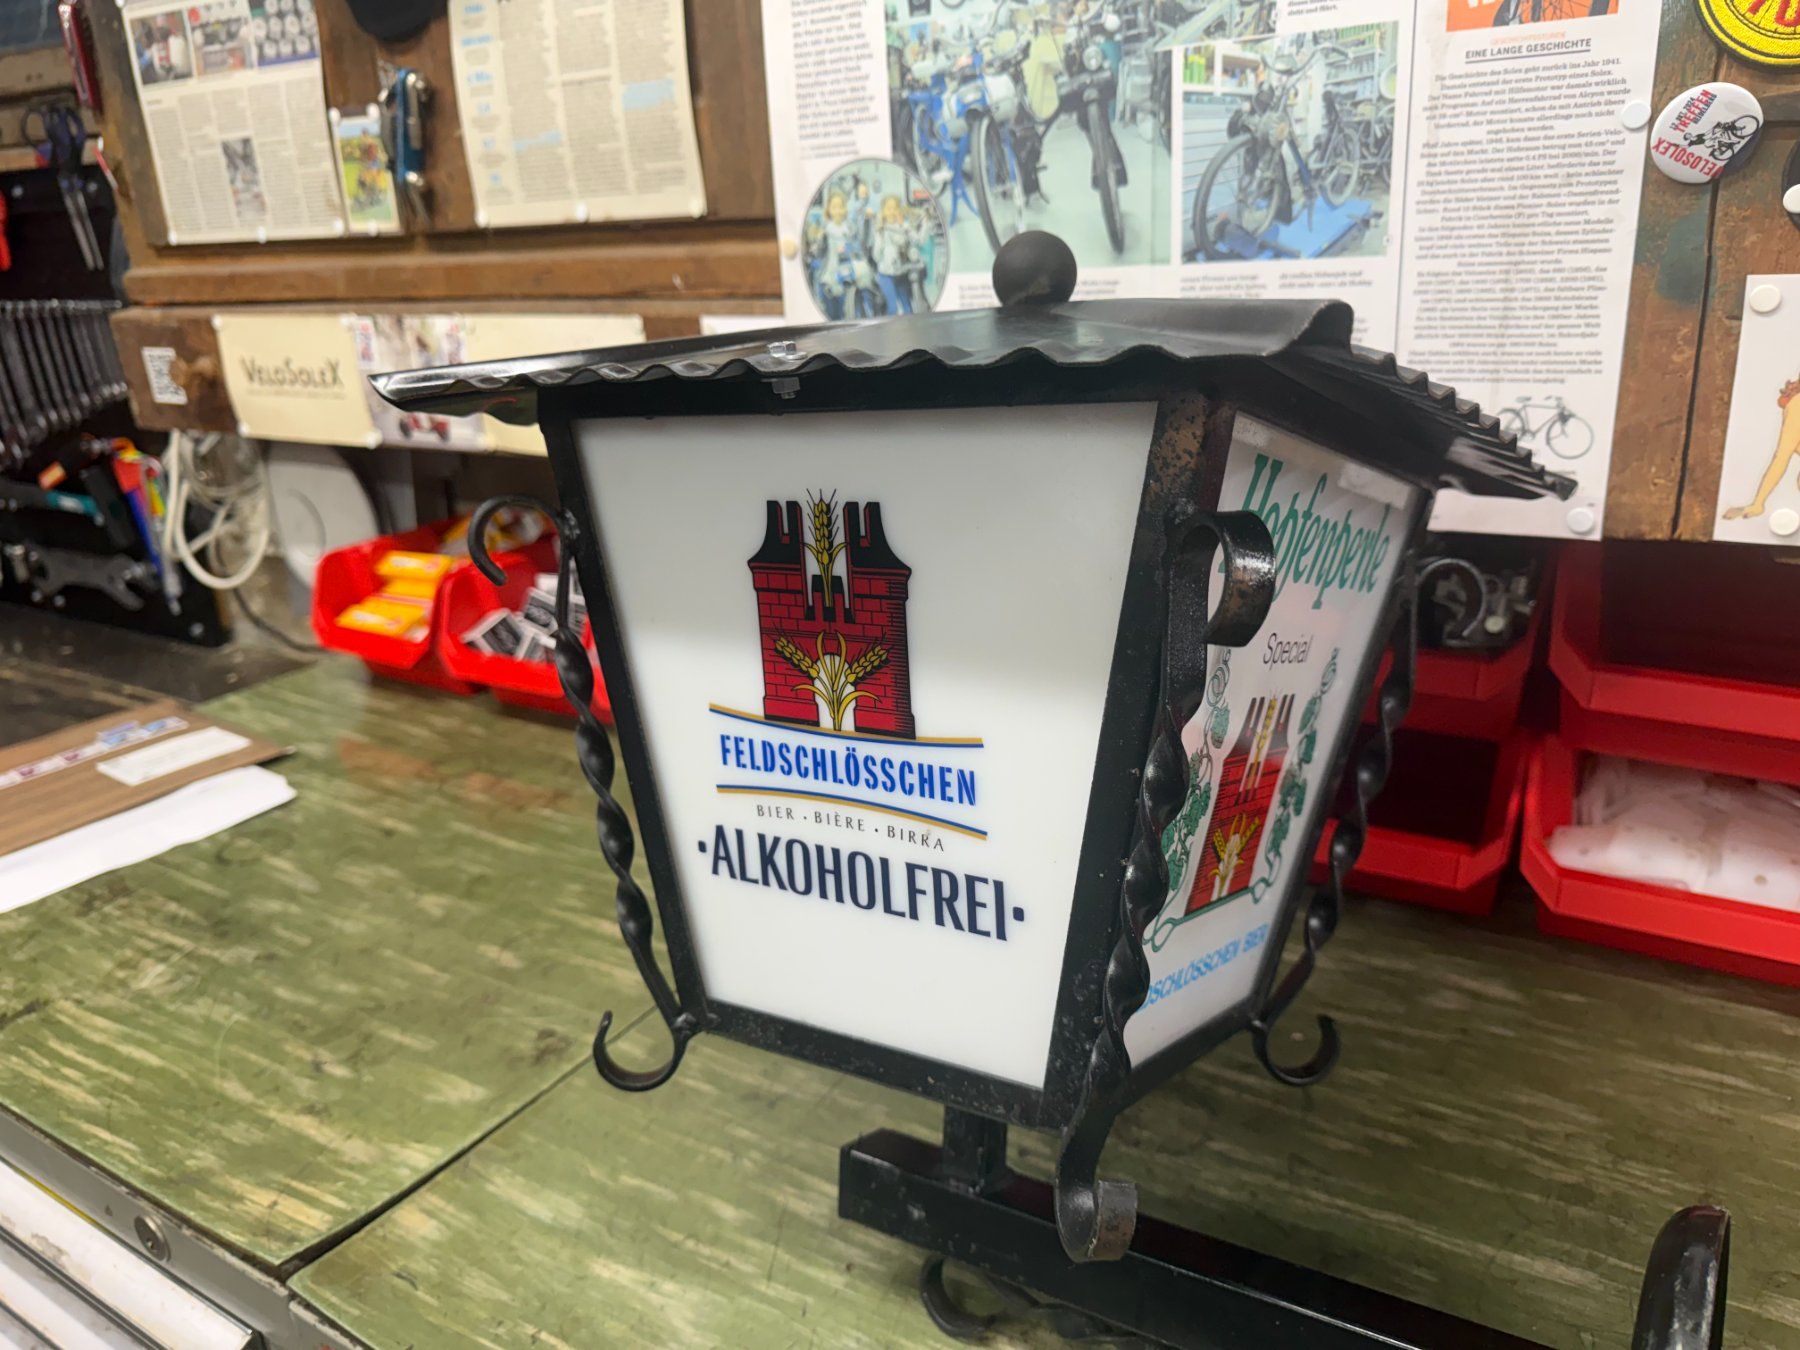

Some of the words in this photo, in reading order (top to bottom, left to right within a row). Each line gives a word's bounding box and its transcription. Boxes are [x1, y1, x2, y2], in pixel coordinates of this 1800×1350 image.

[1465, 49, 1487, 59] EINE
[1490, 44, 1523, 56] LANGE
[1526, 38, 1592, 53] GESCHICHTE
[1675, 89, 1713, 133] TREFFEN
[1652, 137, 1724, 178] VELOSOLEX
[1263, 632, 1314, 671] Special
[719, 734, 977, 806] FELDSCHLÖSSCHEN
[756, 804, 795, 821] BIER
[814, 810, 866, 833] BIÈRE
[886, 825, 945, 852] BIRRA
